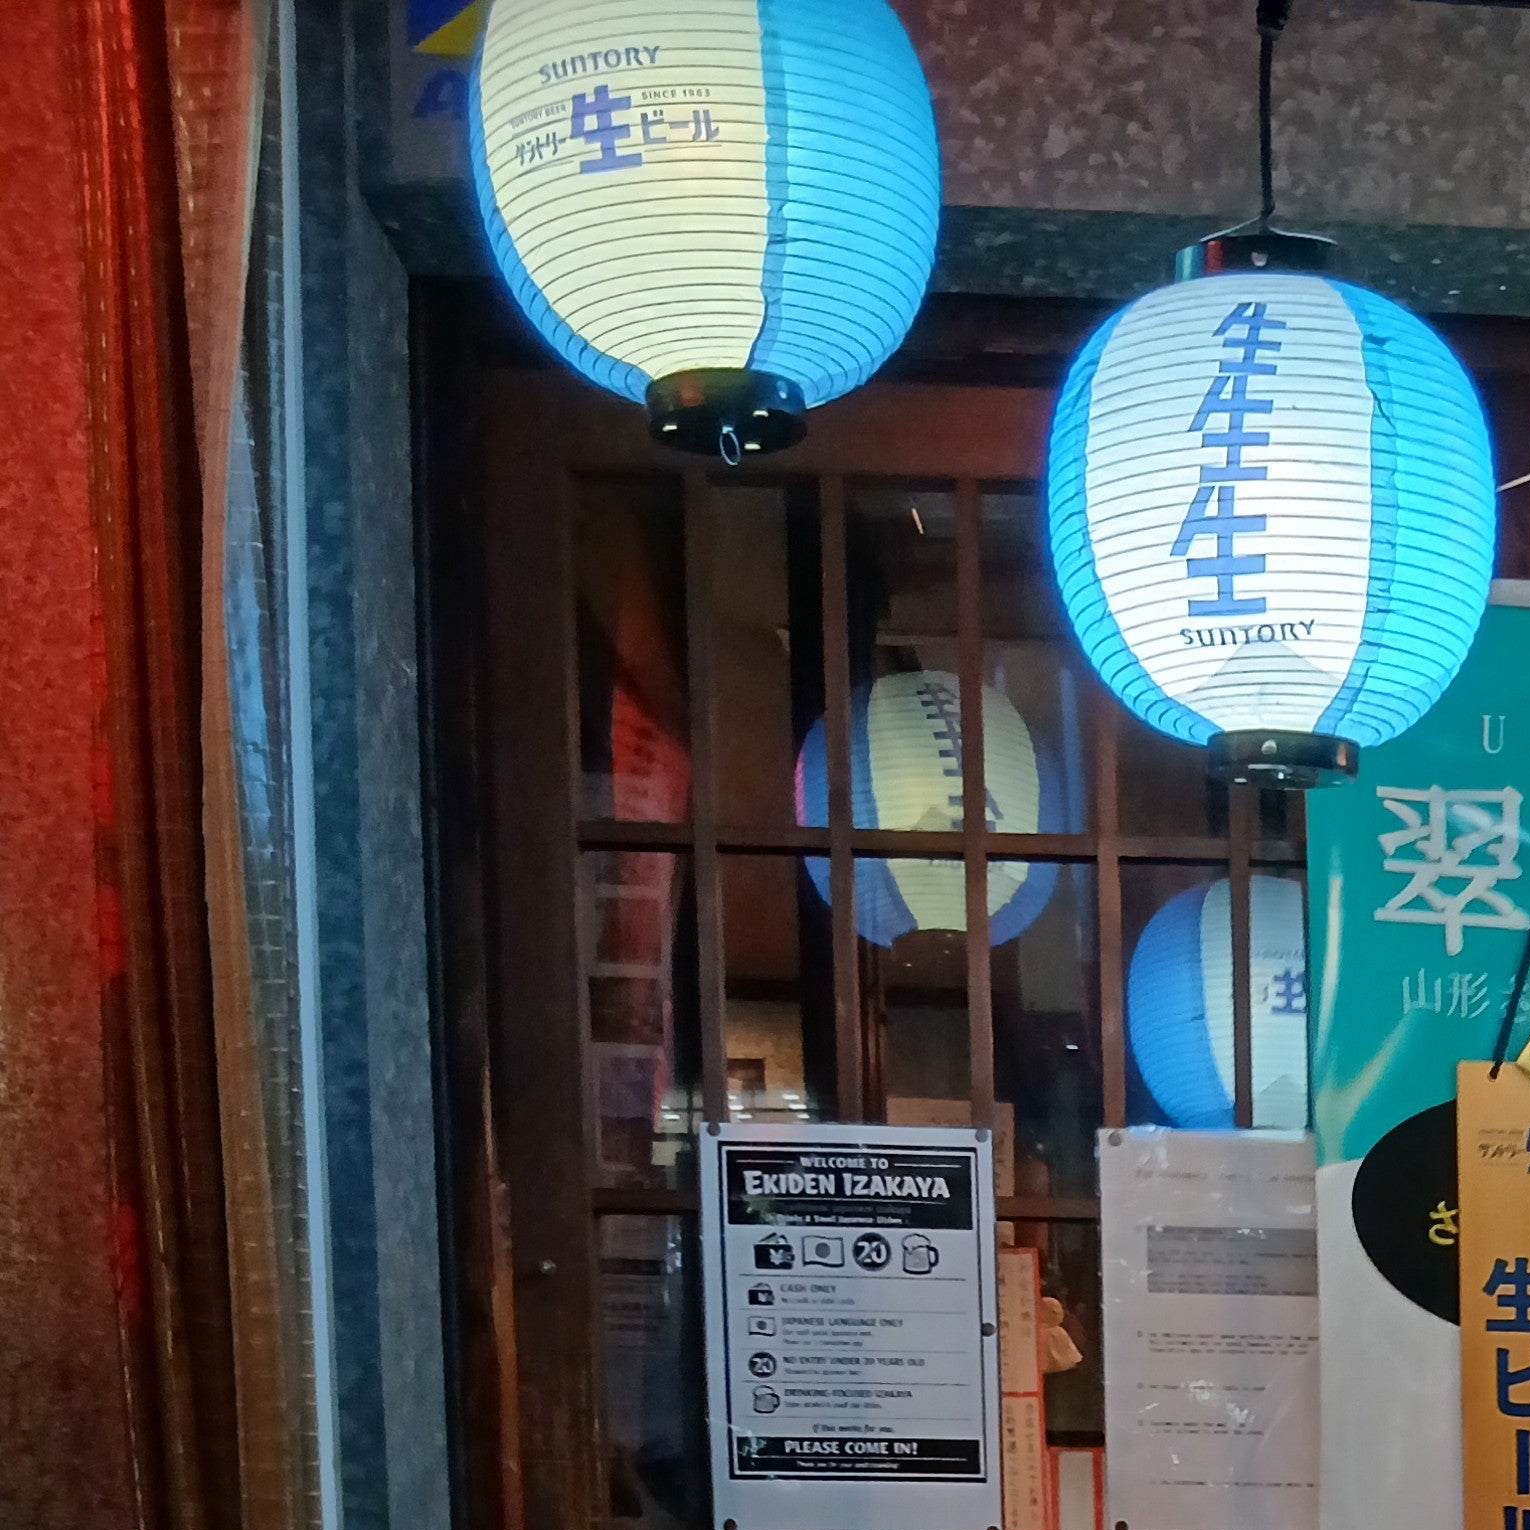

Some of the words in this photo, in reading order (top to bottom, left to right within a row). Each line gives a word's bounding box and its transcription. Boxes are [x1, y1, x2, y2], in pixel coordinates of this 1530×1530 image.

[538, 46, 661, 85] SUNTORY
[641, 89, 677, 100] SINCE
[1170, 301, 1288, 617] 生生生
[1180, 619, 1317, 647] SUNTORY
[799, 1156, 866, 1168] WELCOME
[870, 1157, 889, 1169] TO
[743, 1170, 836, 1195] EKIDEN
[842, 1172, 951, 1198] IZAKAYA
[784, 1440, 840, 1455] PLEASE
[844, 1441, 889, 1455] COME
[893, 1441, 918, 1456] IN!
